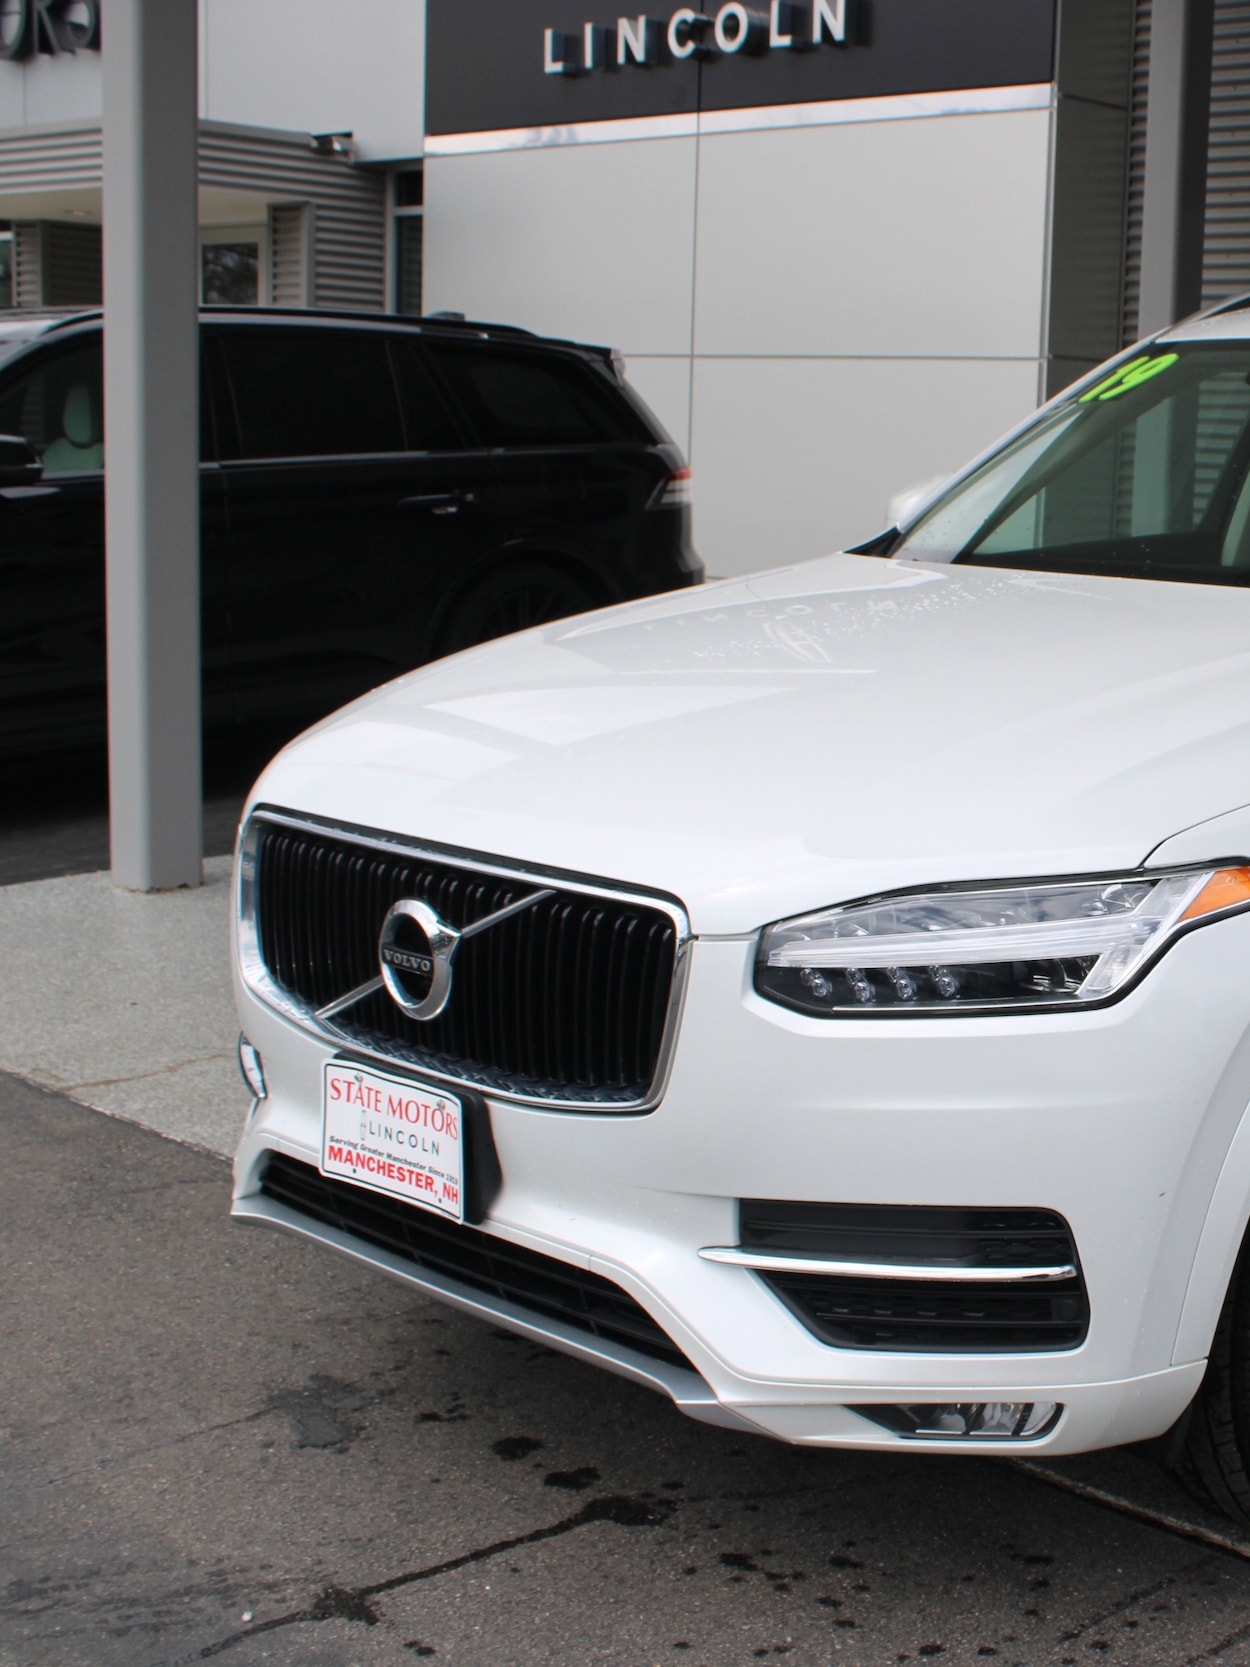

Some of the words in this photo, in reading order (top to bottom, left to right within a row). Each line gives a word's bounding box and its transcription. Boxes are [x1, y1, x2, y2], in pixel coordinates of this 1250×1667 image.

[544, 0, 847, 74] LINCOLN
[383, 949, 432, 972] VOLVO
[330, 1078, 382, 1113] STATE
[387, 1094, 458, 1141] MOTORS
[329, 1135, 358, 1150] Serving
[360, 1143, 384, 1157] Greater
[386, 1152, 426, 1171] Manchester
[428, 1165, 444, 1179] Since
[368, 1120, 440, 1157] LINCOLN
[328, 1144, 439, 1198] MANCHESTER,
[442, 1183, 459, 1205] NH
